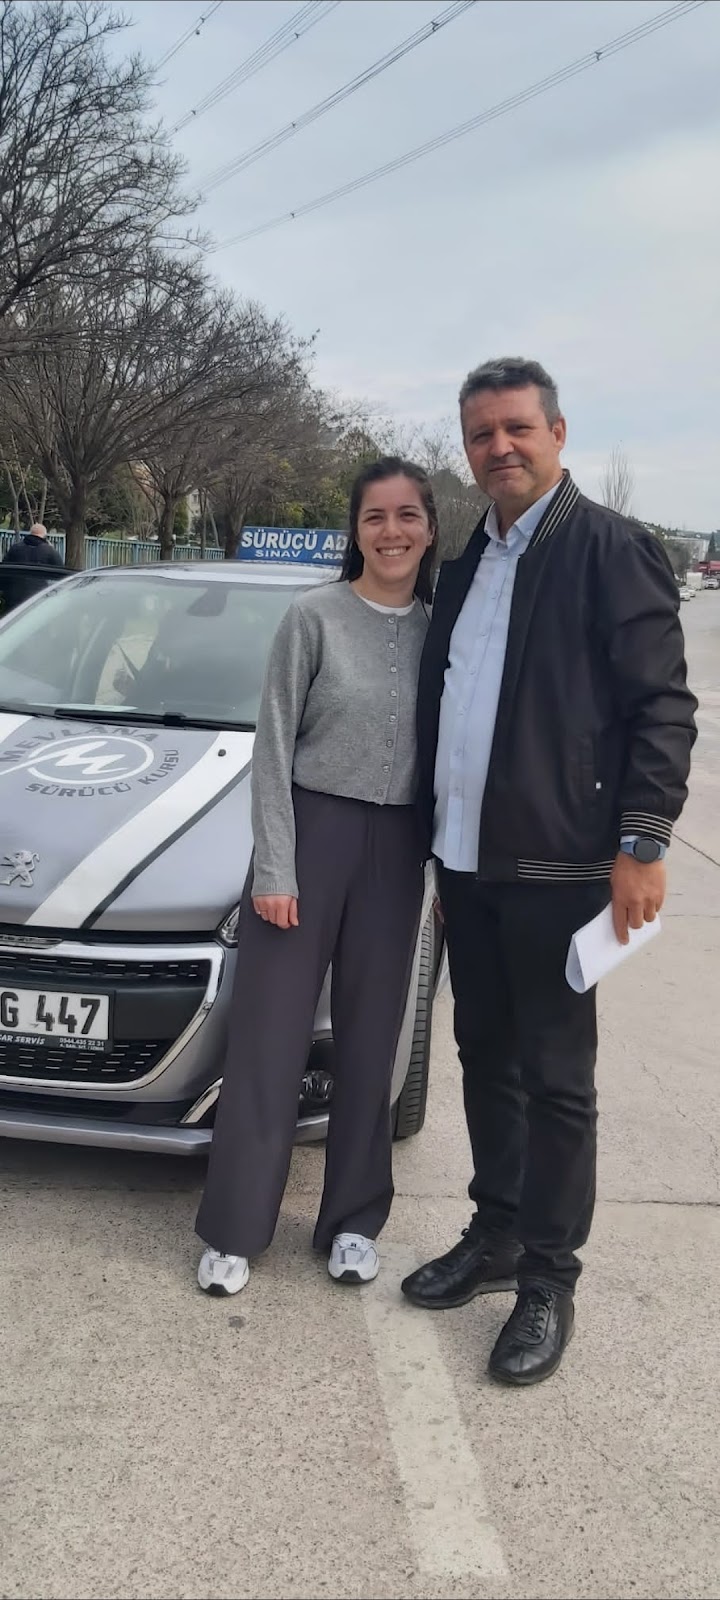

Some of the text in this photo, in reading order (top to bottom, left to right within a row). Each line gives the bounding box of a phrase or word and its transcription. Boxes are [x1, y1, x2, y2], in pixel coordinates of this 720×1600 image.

[241, 528, 318, 550] SÜRÜCÜ
[255, 550, 343, 560] SINAV ARA
[0, 726, 159, 763] MEVLANA
[25, 749, 179, 797] SÜRÜCÜ KURSU
[36, 994, 100, 1034] 447
[15, 1036, 45, 1045] SERVİS
